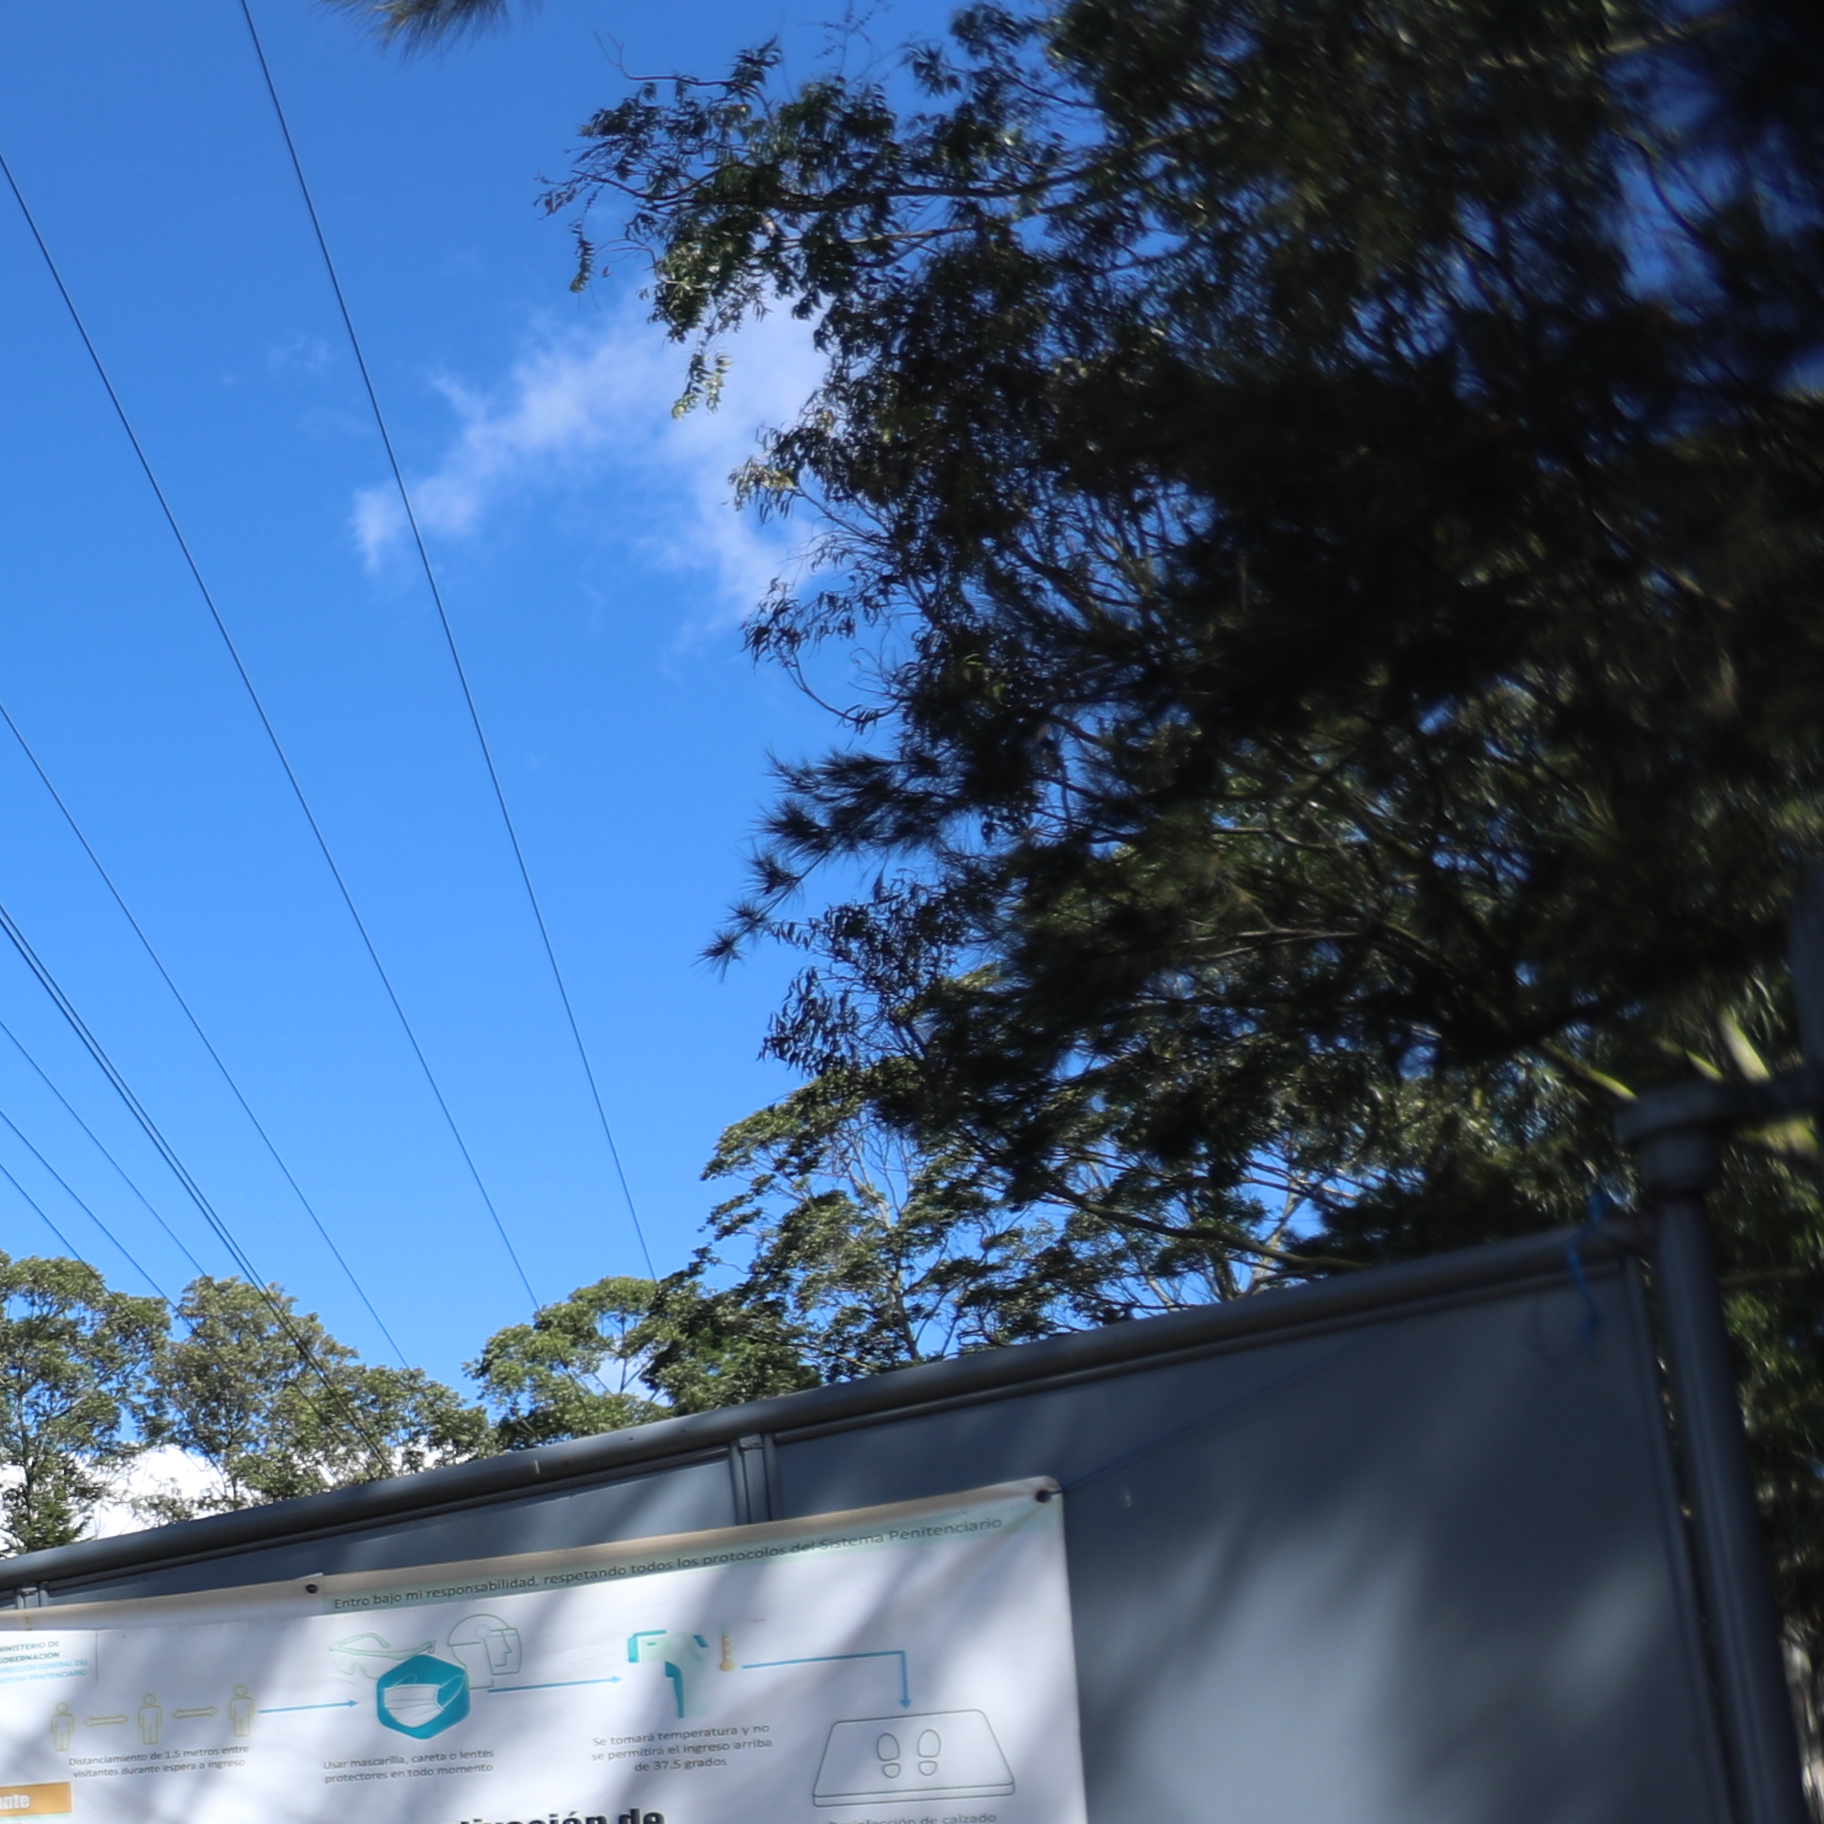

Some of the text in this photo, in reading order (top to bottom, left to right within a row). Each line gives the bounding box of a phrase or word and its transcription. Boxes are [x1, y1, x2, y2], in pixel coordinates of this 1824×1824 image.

[334, 1518, 1001, 1609] Entro bajo mi responsabilidad, respetando todos los protocolos del Sistema Penitenciario
[593, 1725, 769, 1747] Se tomará temperatura y no
[69, 1745, 249, 1766] Distanciamiento de 1.5 metros entre
[323, 1761, 347, 1769] Usar
[350, 1755, 408, 1768] mascarilla,
[412, 1754, 447, 1763] careta
[459, 1750, 494, 1759] lentes
[592, 1738, 772, 1761] se permitirá el ingreso arriba
[73, 1758, 245, 1778] visitantes durante espera a ingreso
[324, 1764, 493, 1785] protectores en todo momento
[635, 1757, 727, 1772] de 37.5 grados
[942, 1813, 996, 1824] calzado
